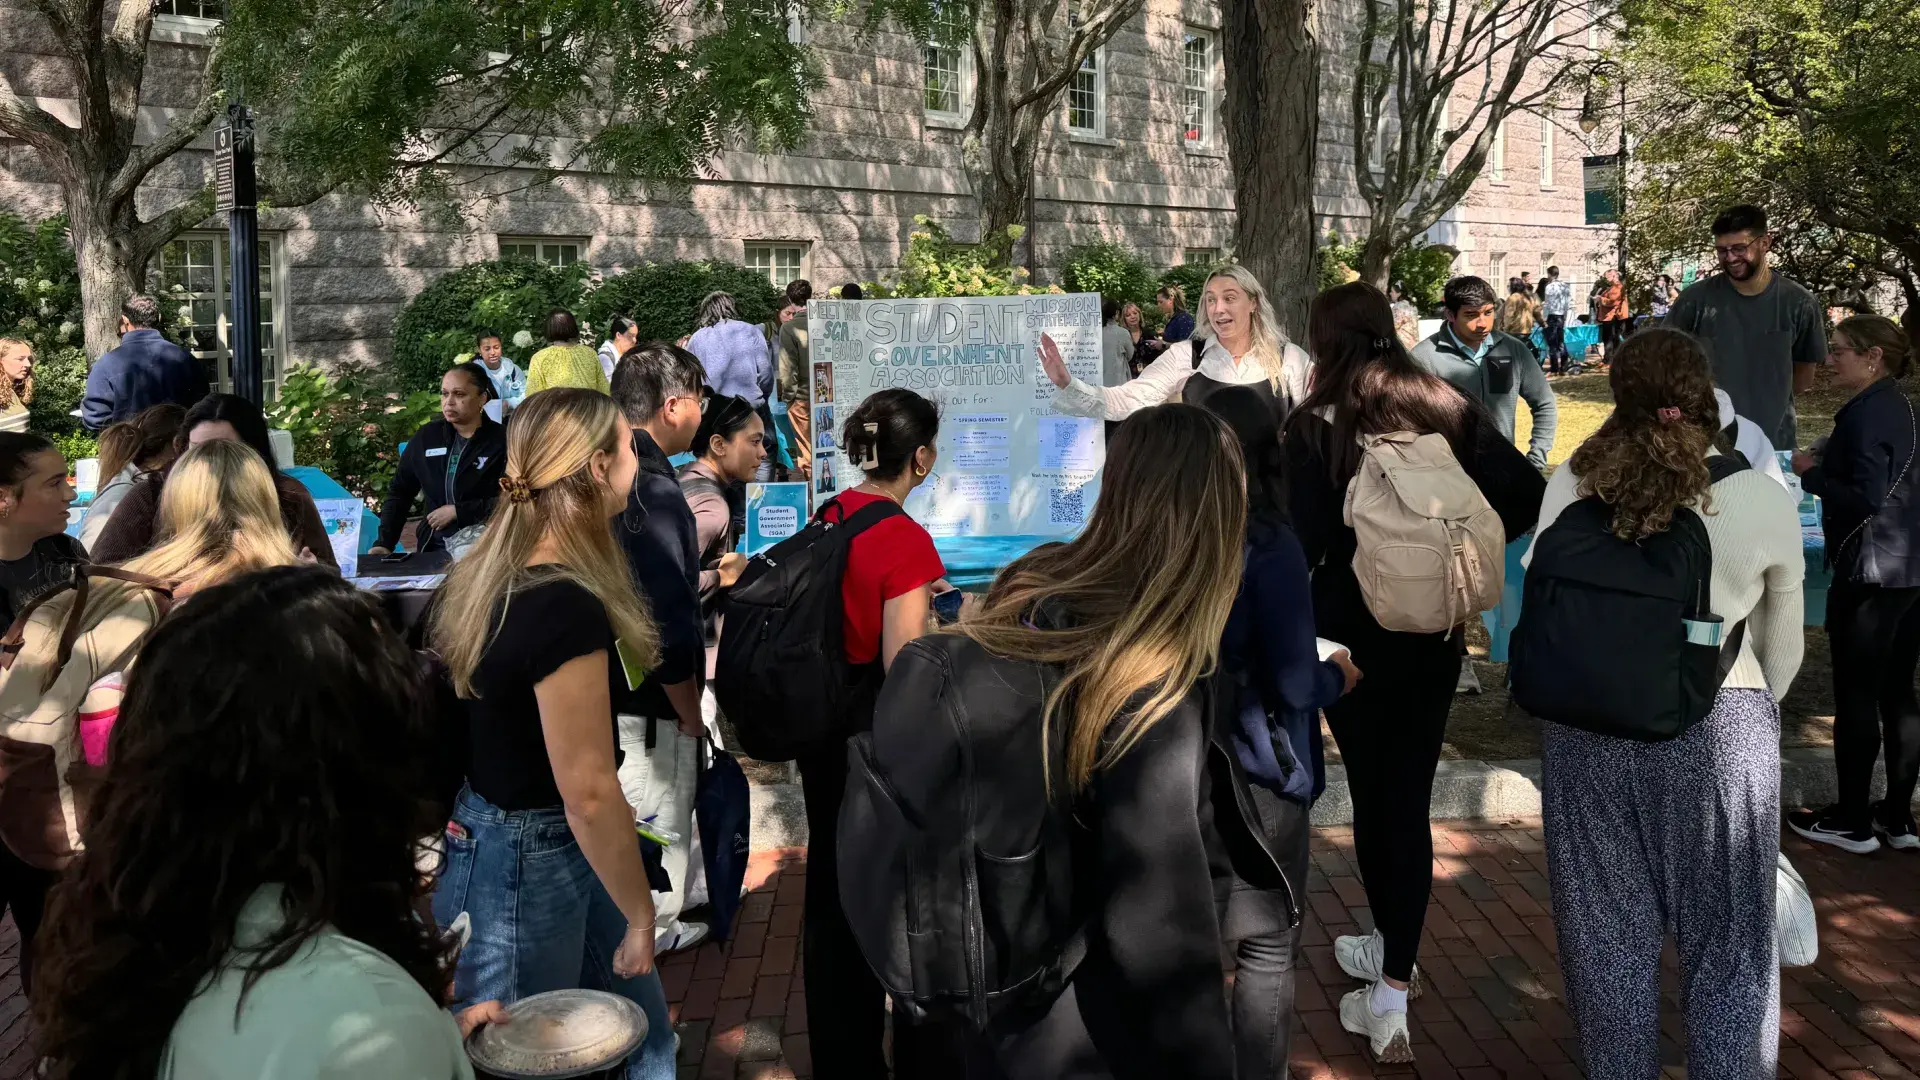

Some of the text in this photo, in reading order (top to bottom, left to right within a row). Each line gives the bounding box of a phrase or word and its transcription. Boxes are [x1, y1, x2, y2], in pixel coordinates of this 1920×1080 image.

[808, 301, 840, 320] MEET
[1025, 296, 1096, 314] MISSION
[823, 320, 849, 341] SGA
[866, 302, 1024, 344] STUDENT
[813, 339, 863, 361] E-BOARD
[869, 344, 1025, 366] GOVERNMENT
[870, 365, 1025, 389] ASSOCIATION
